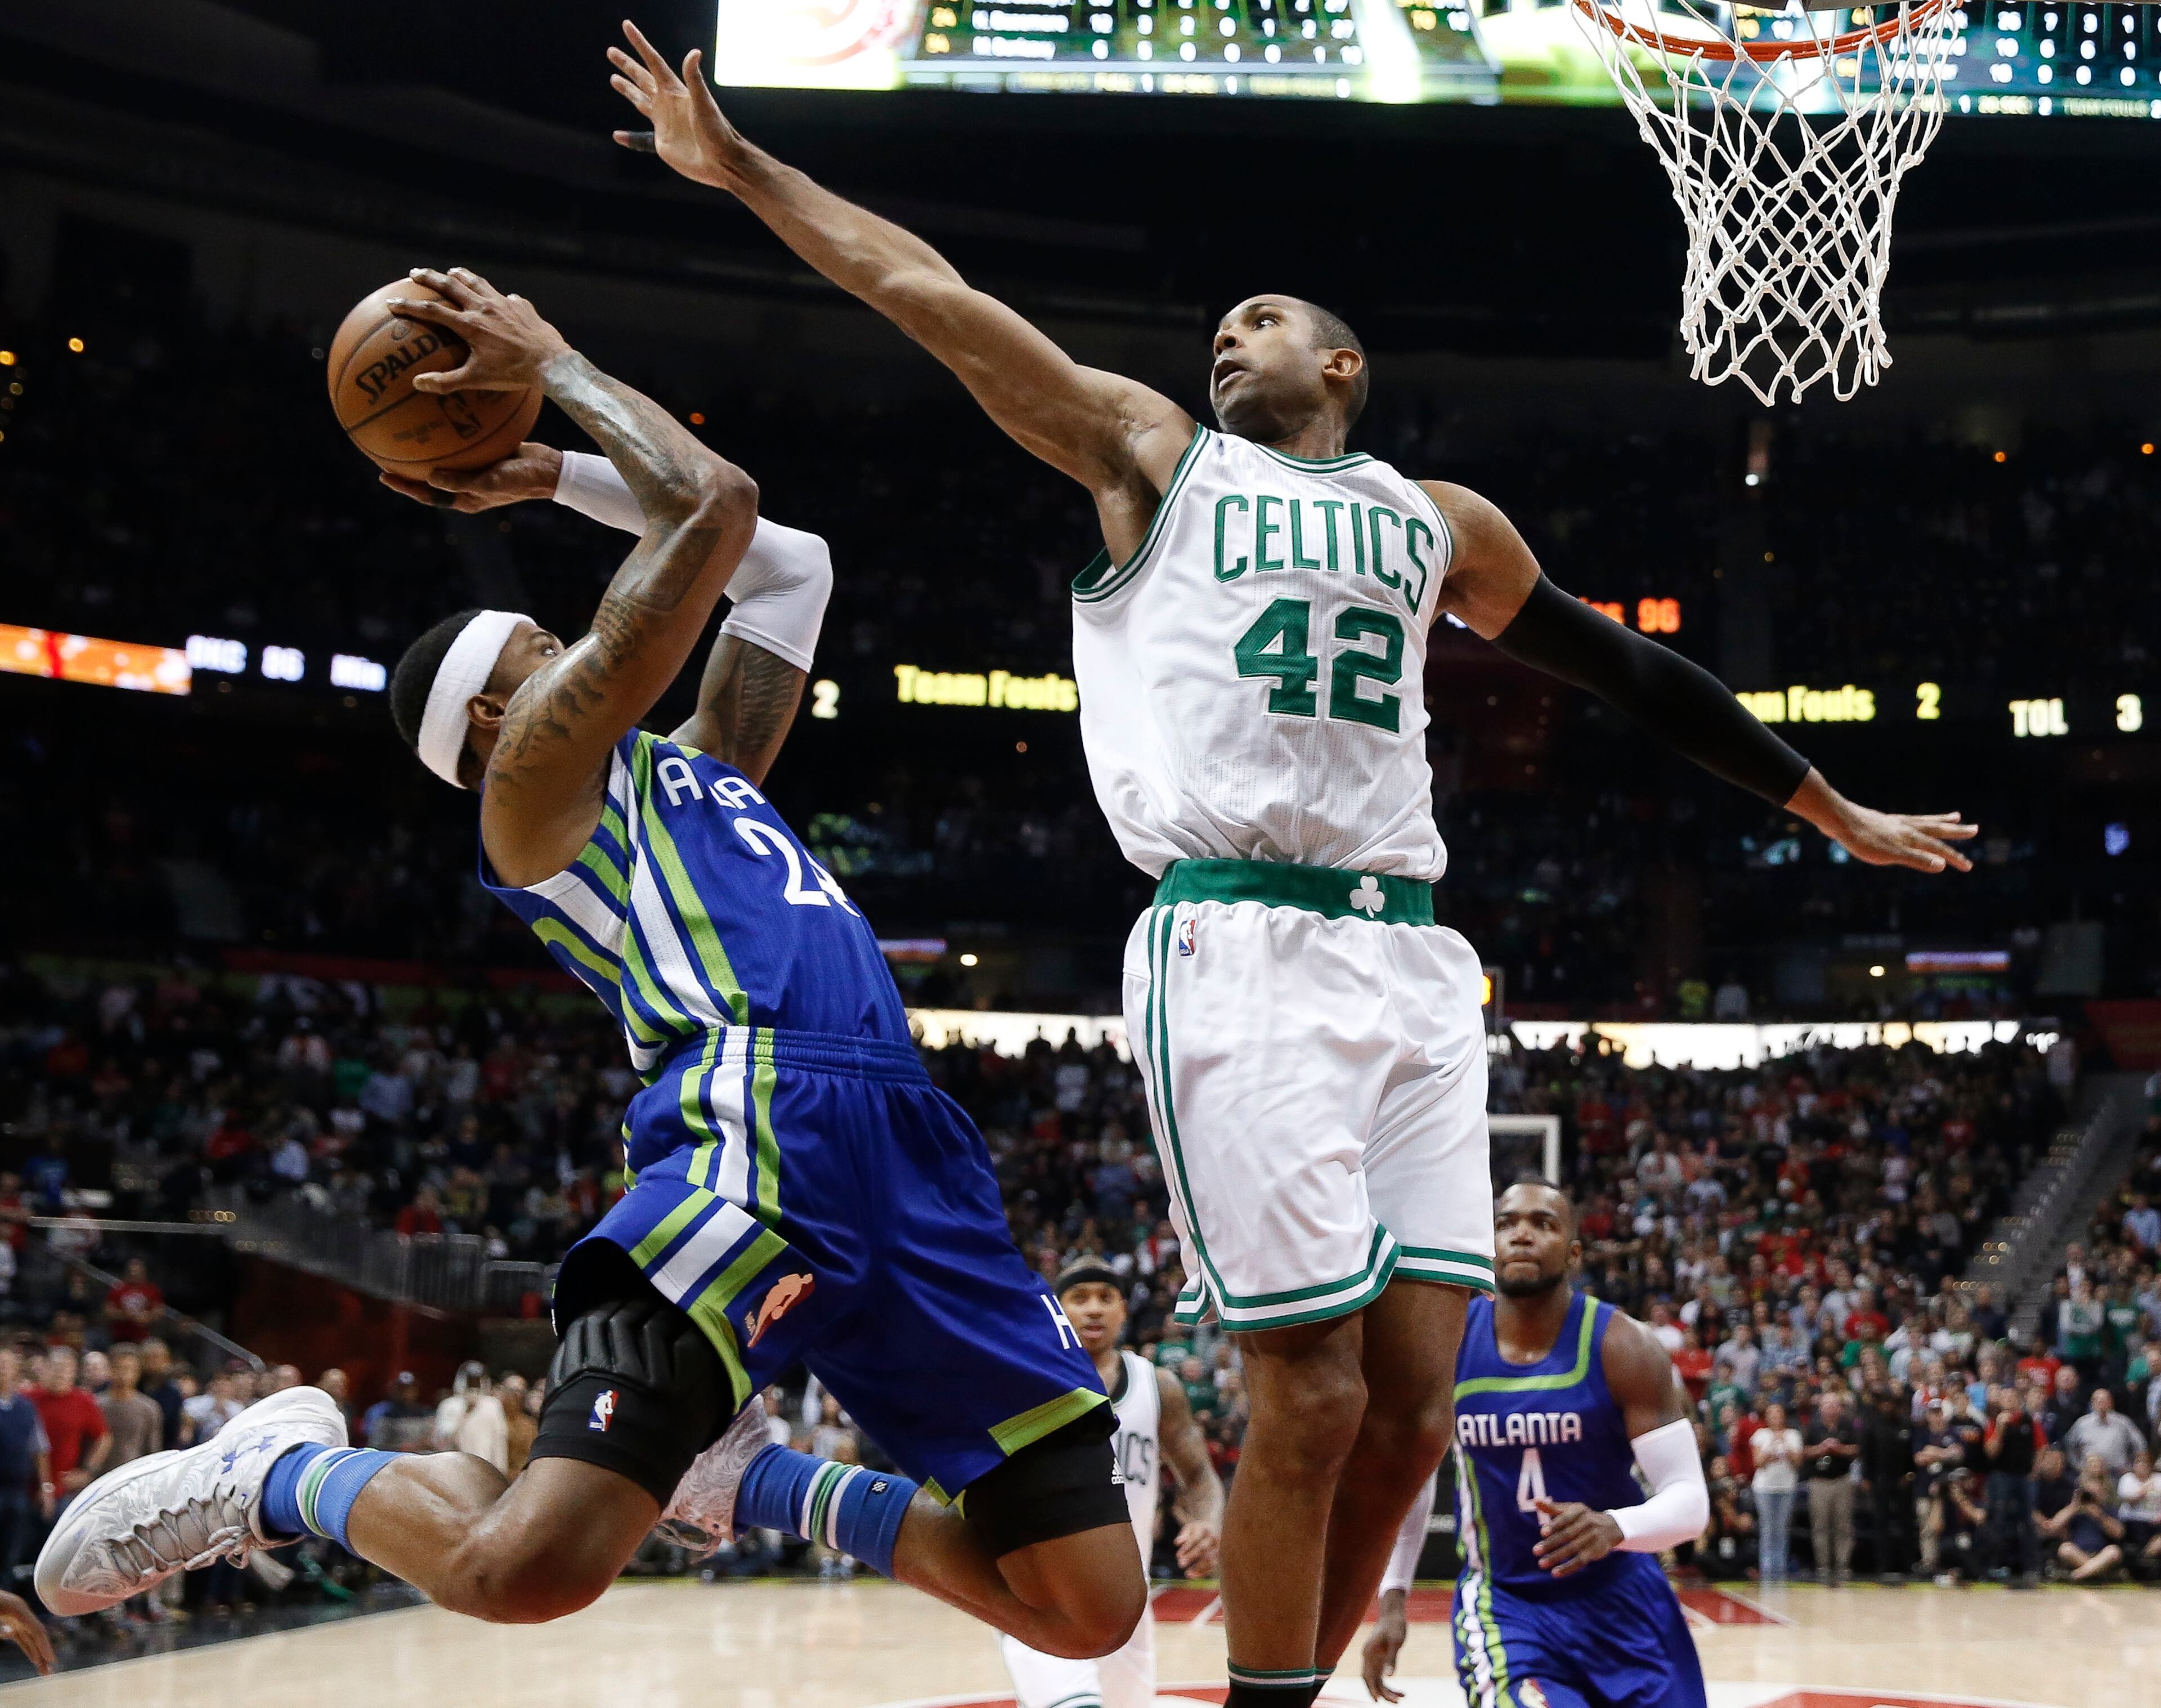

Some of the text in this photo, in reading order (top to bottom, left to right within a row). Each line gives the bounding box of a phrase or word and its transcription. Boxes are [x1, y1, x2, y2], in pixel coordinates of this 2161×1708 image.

[355, 333, 442, 405] SPALD
[1213, 494, 1434, 617] CELTICS
[895, 664, 988, 706] Team
[1234, 596, 1405, 734] 42
[812, 679, 840, 719] 2
[1787, 684, 1876, 723] Fouls
[1916, 682, 1941, 719] 2
[2009, 693, 2142, 737] TOL 3
[1456, 1411, 1583, 1447] ATLANTA
[1516, 1447, 1554, 1527] 4
